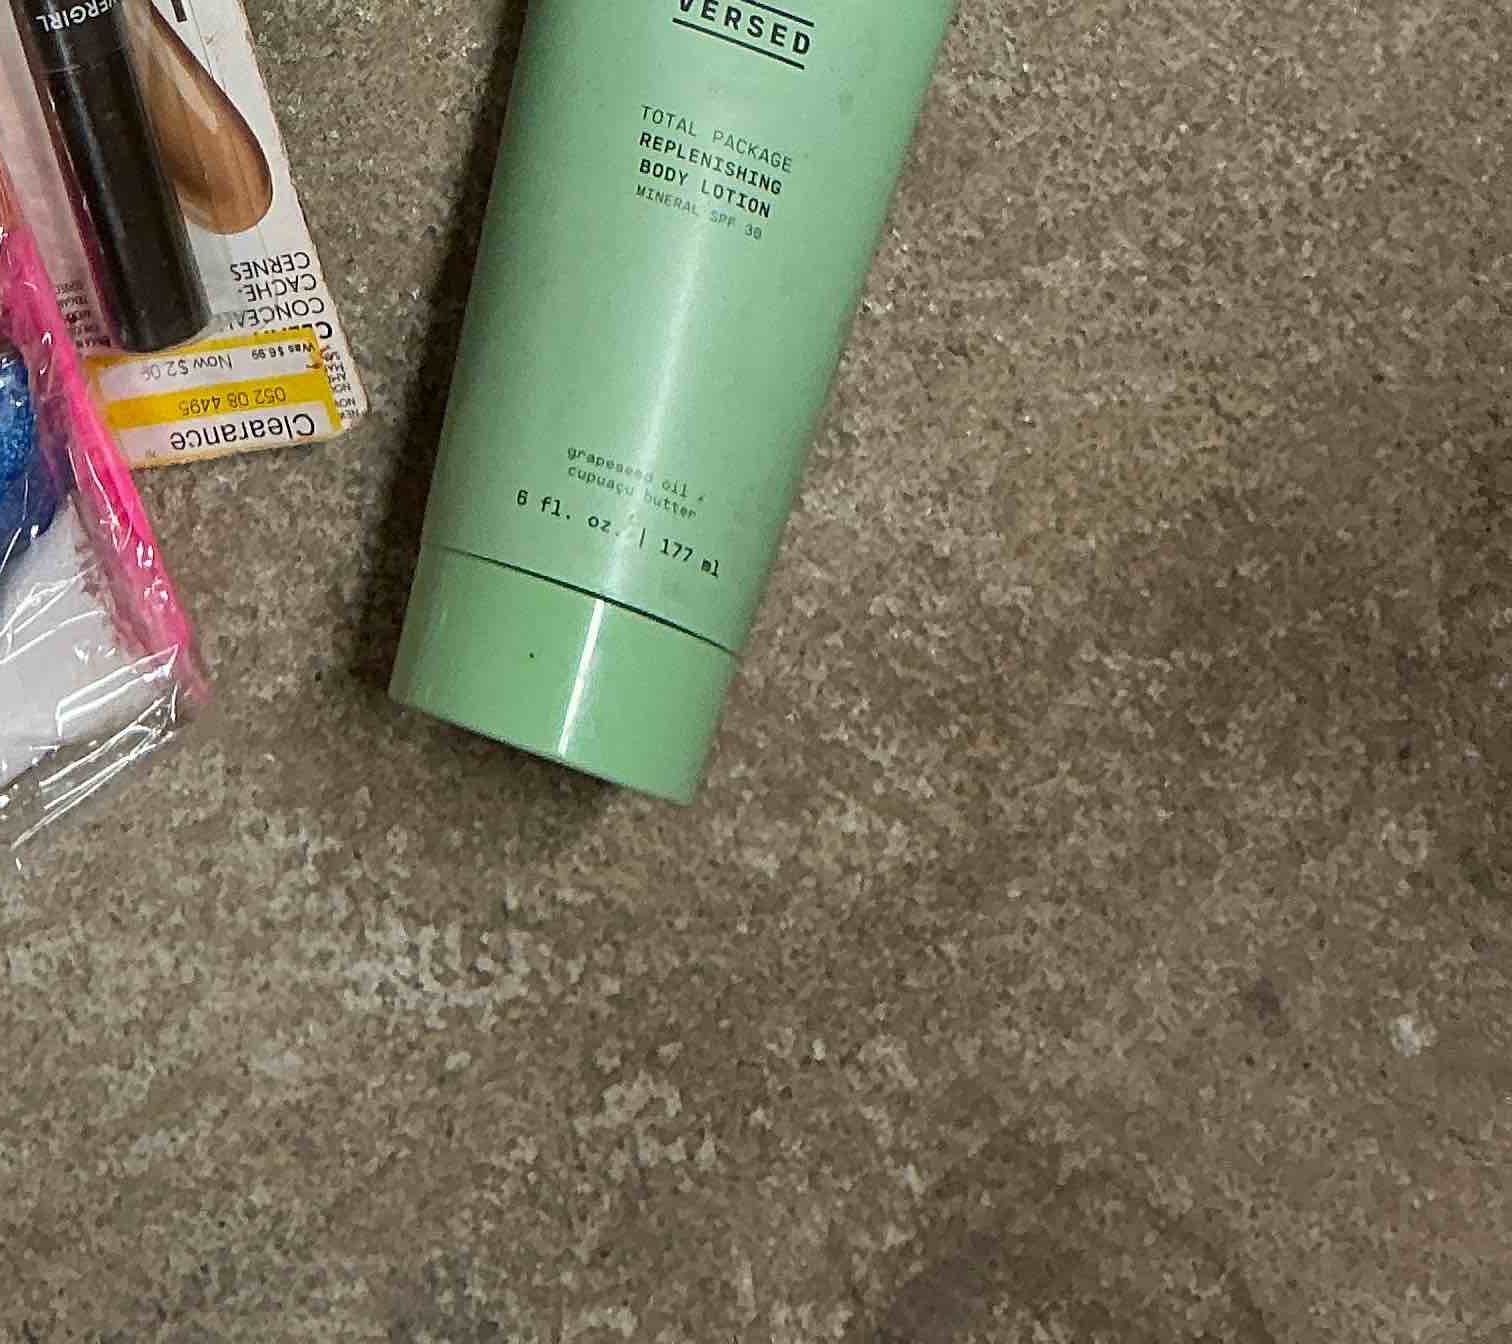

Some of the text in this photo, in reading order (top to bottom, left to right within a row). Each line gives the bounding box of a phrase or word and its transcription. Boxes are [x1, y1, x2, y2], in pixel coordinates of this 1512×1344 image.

[638, 131, 782, 195] REPLENISHING
[641, 104, 792, 173] TOTAL PACKAGE
[635, 183, 764, 239] MINERAL SPF 30
[639, 158, 770, 218] BODY LOTION
[229, 249, 311, 281] CERNES
[192, 339, 314, 370] Was $6.99 Now
[178, 384, 286, 416] 052 08 4495
[169, 412, 315, 464] Clearance
[640, 492, 696, 519] butter
[661, 479, 687, 498] oil
[514, 488, 530, 507] 6
[540, 495, 570, 520] fl.
[660, 537, 693, 562] 177
[699, 555, 721, 576] ml
